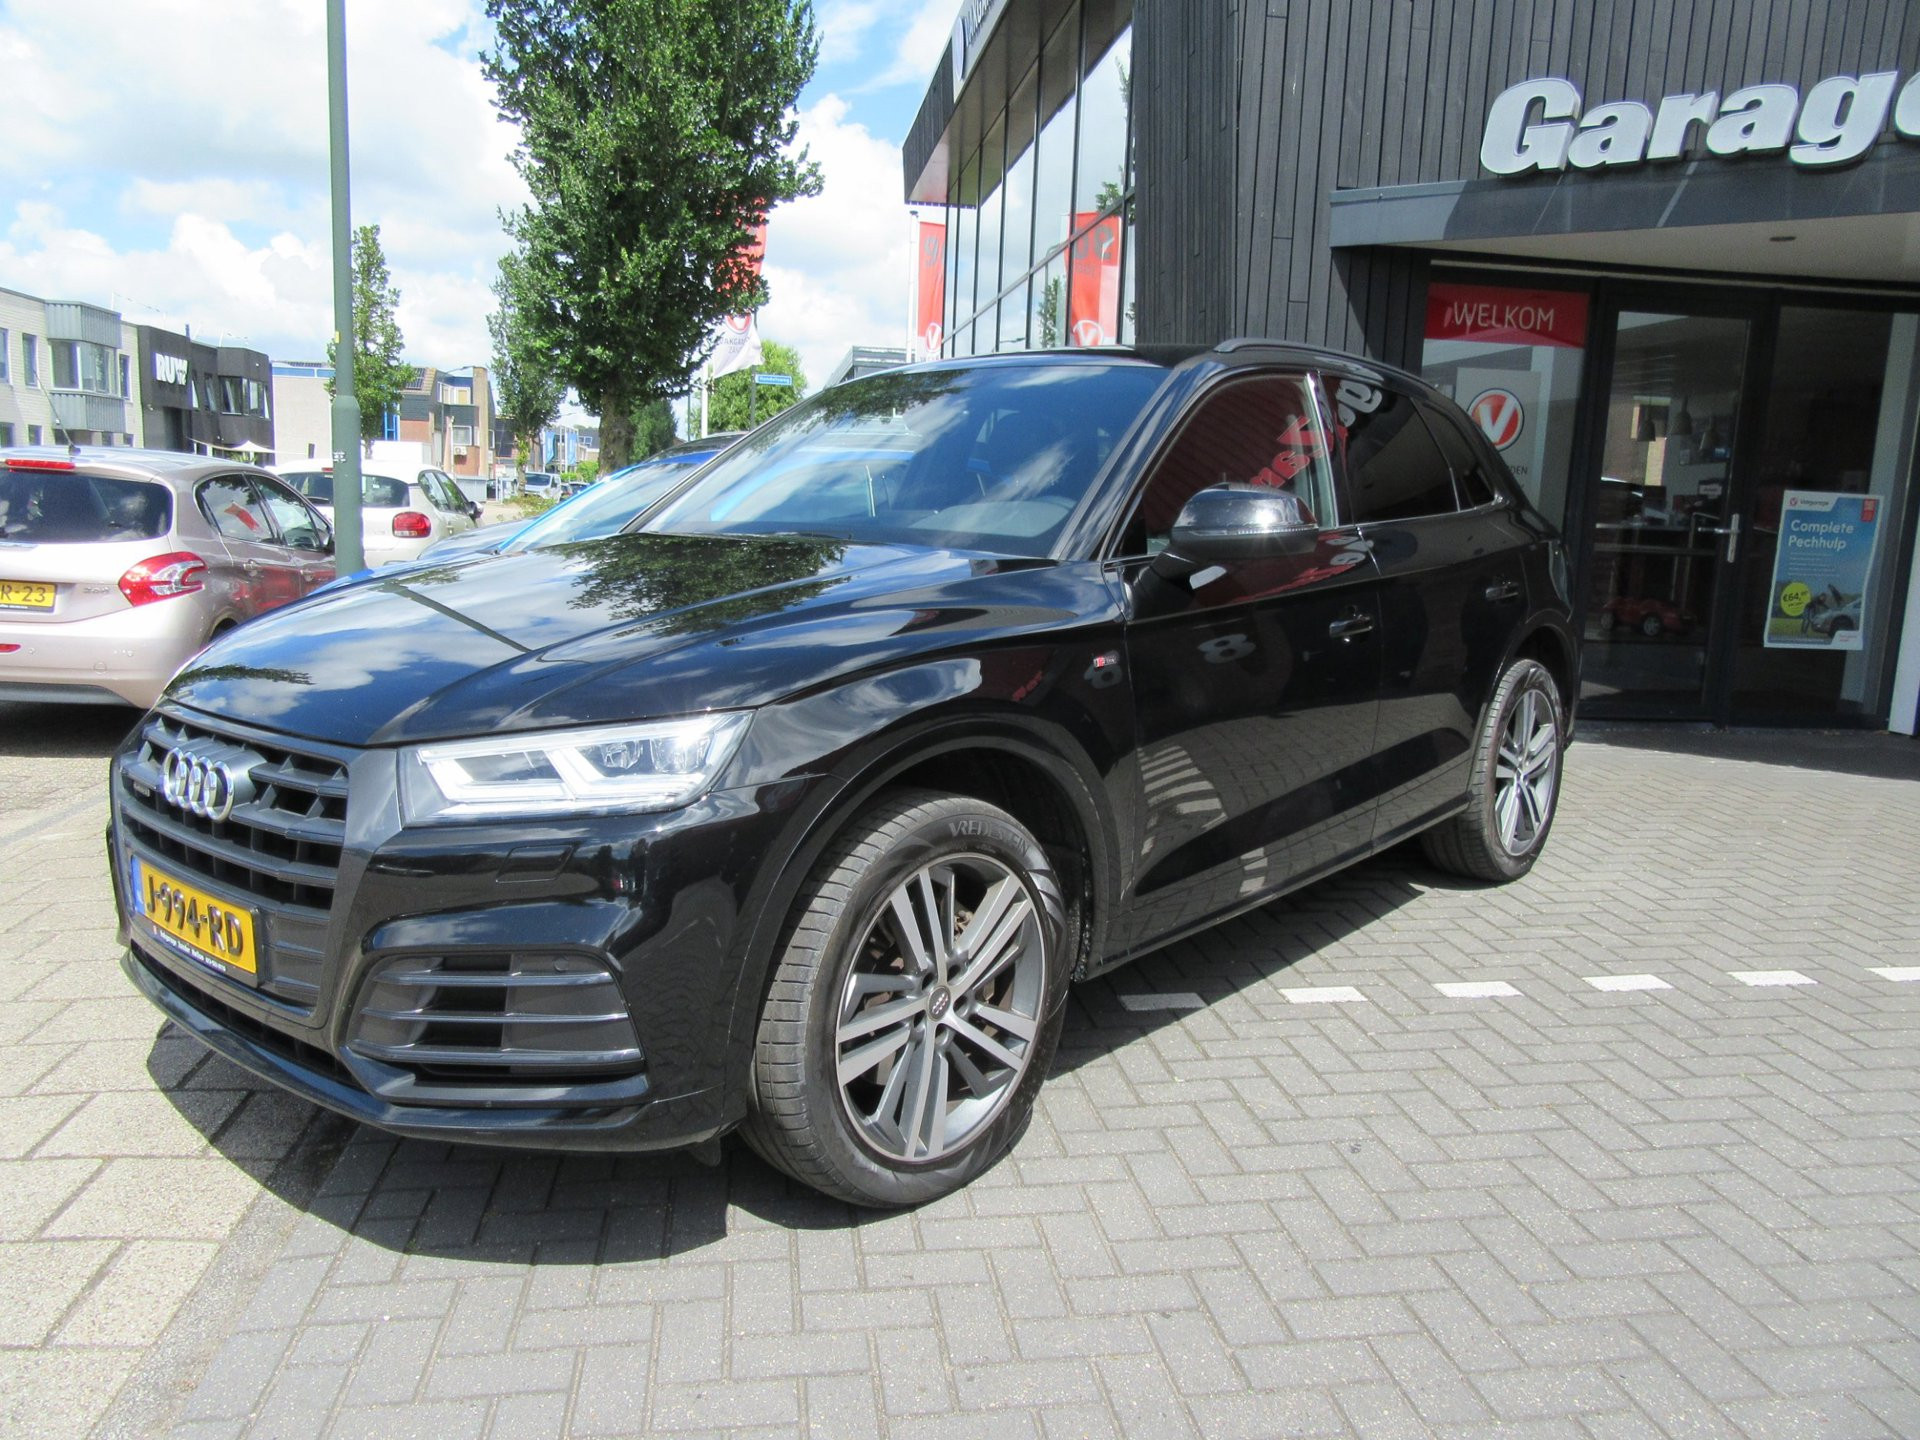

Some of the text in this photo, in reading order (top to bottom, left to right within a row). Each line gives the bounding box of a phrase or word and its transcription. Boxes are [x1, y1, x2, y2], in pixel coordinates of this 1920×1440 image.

[1453, 301, 1555, 332] WELKOM
[1790, 519, 1854, 536] Complete
[1788, 535, 1847, 552] Pechhulp
[146, 874, 244, 957] J-994-RD
